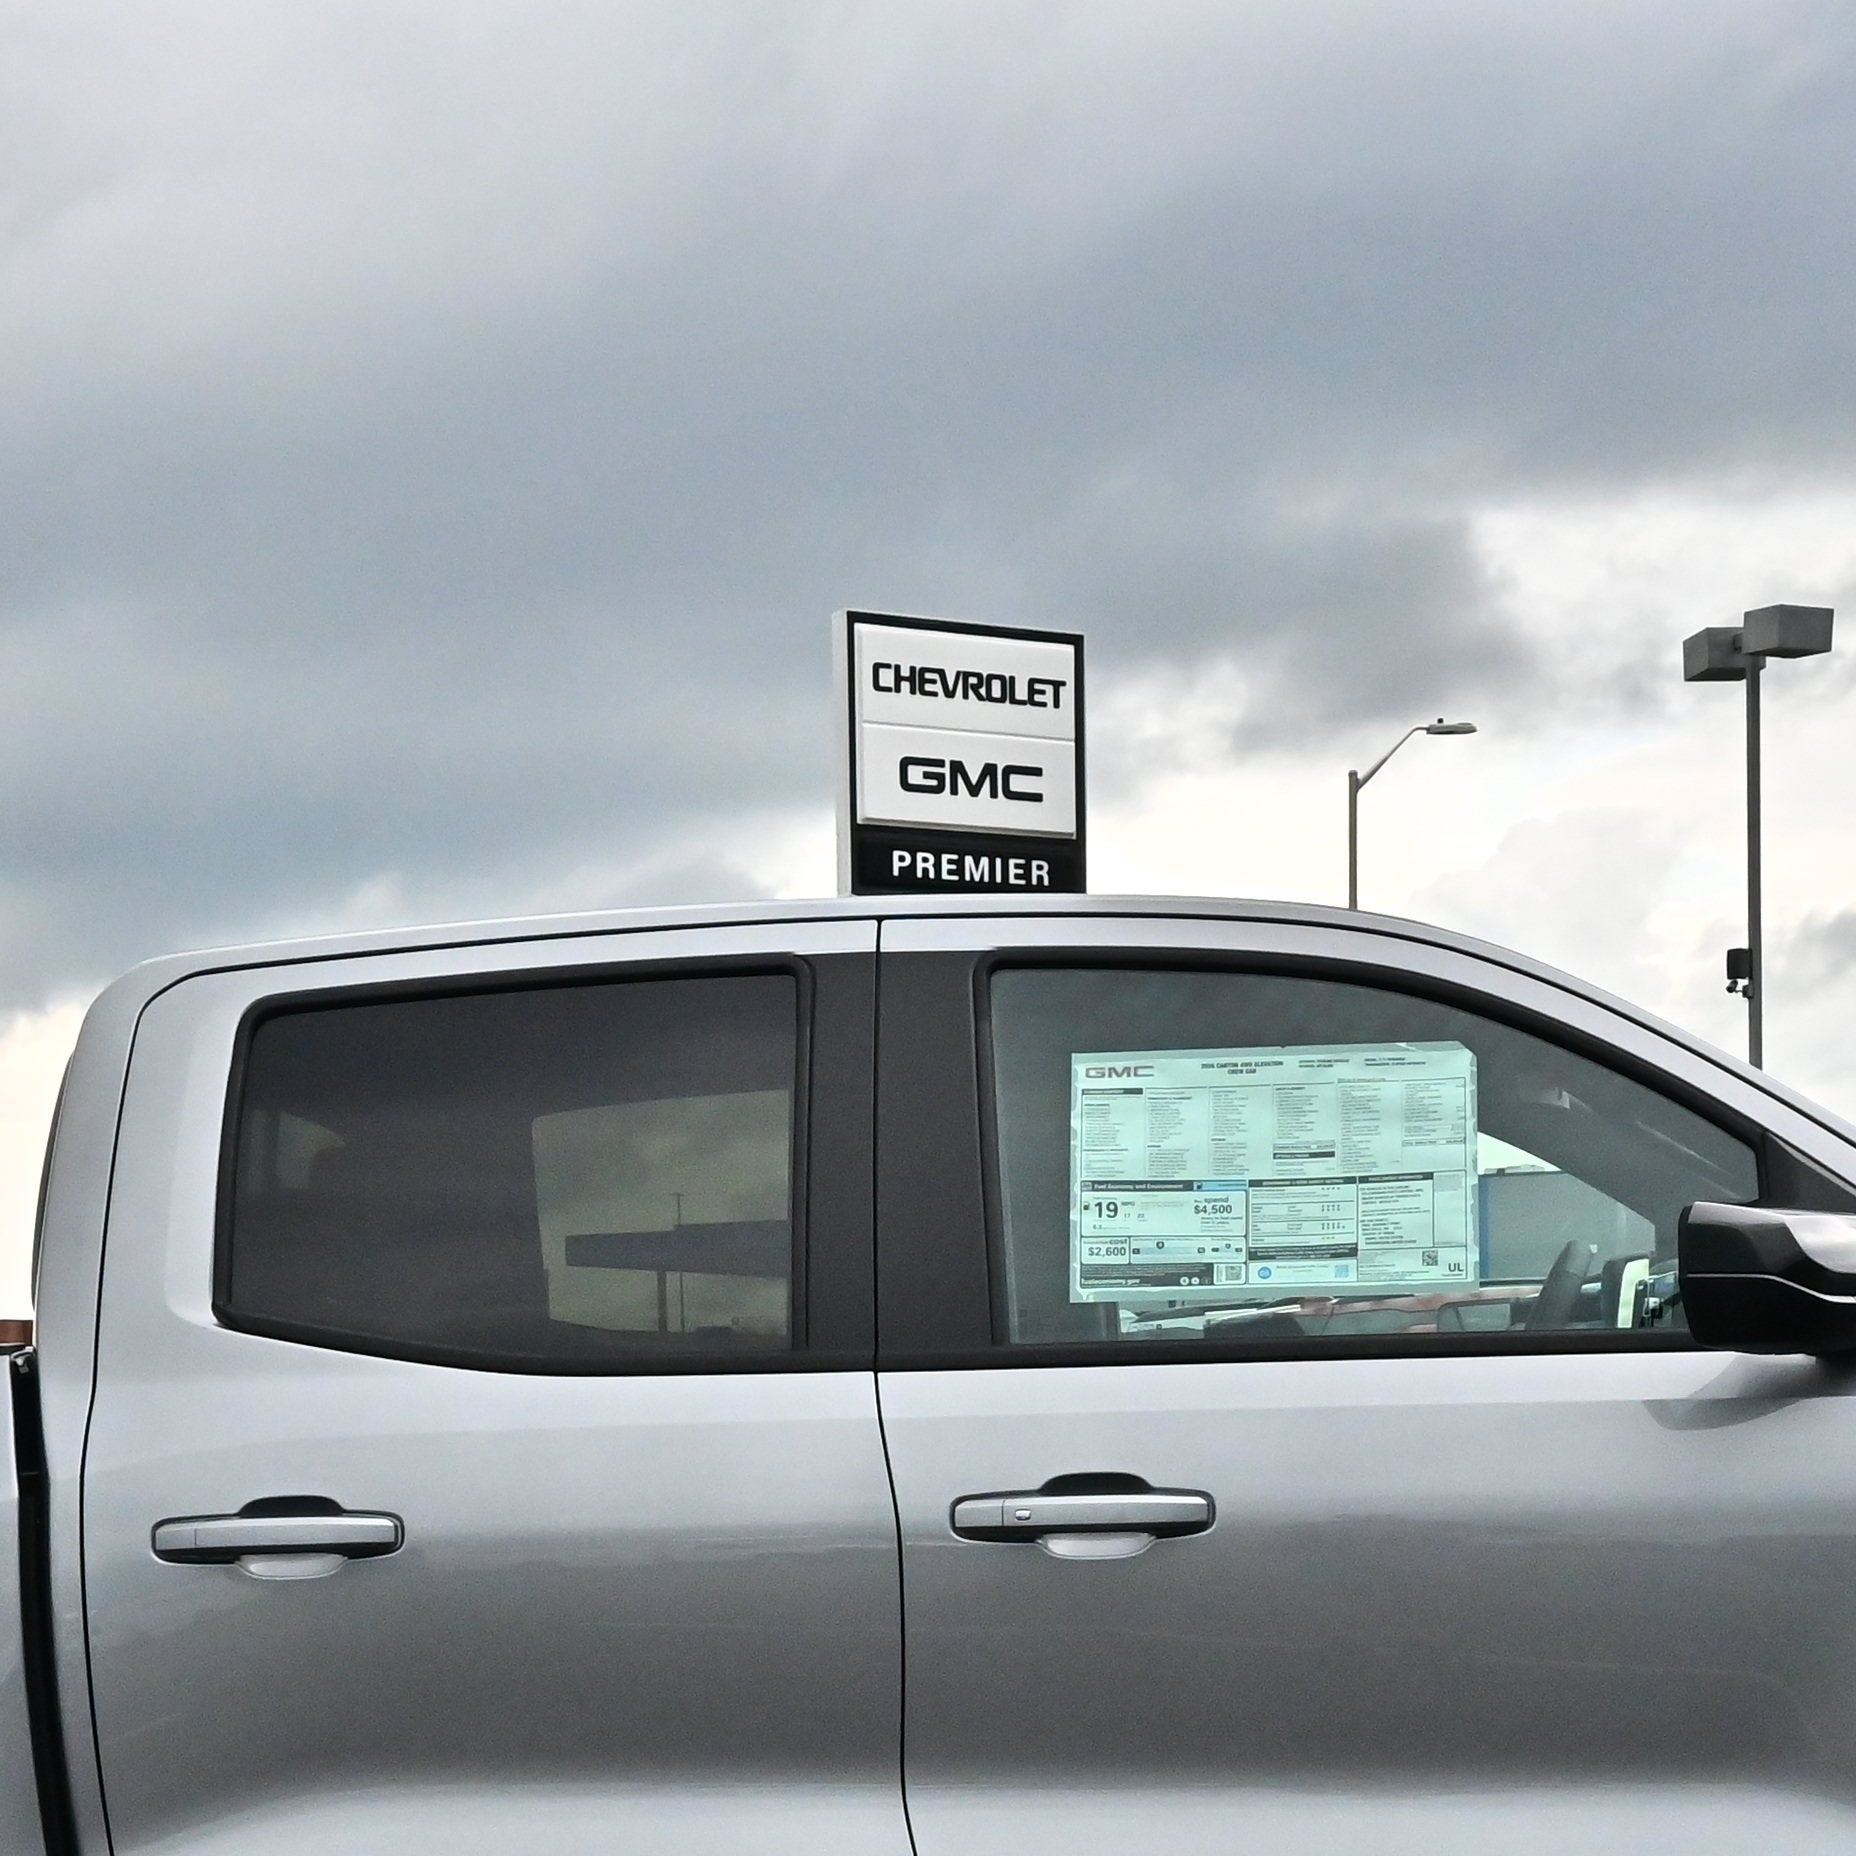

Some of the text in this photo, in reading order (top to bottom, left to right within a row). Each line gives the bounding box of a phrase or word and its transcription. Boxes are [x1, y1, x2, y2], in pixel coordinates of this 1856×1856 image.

[871, 661, 1067, 709] CHEVROLET
[899, 756, 1044, 802] GMC
[892, 850, 1050, 886] PREMIER
[1085, 1065, 1155, 1079] GMC
[1094, 1201, 1119, 1219] 19
[1194, 1204, 1233, 1216] $4,500
[1088, 1246, 1127, 1257] $2,600
[1448, 1262, 1464, 1273] UL
